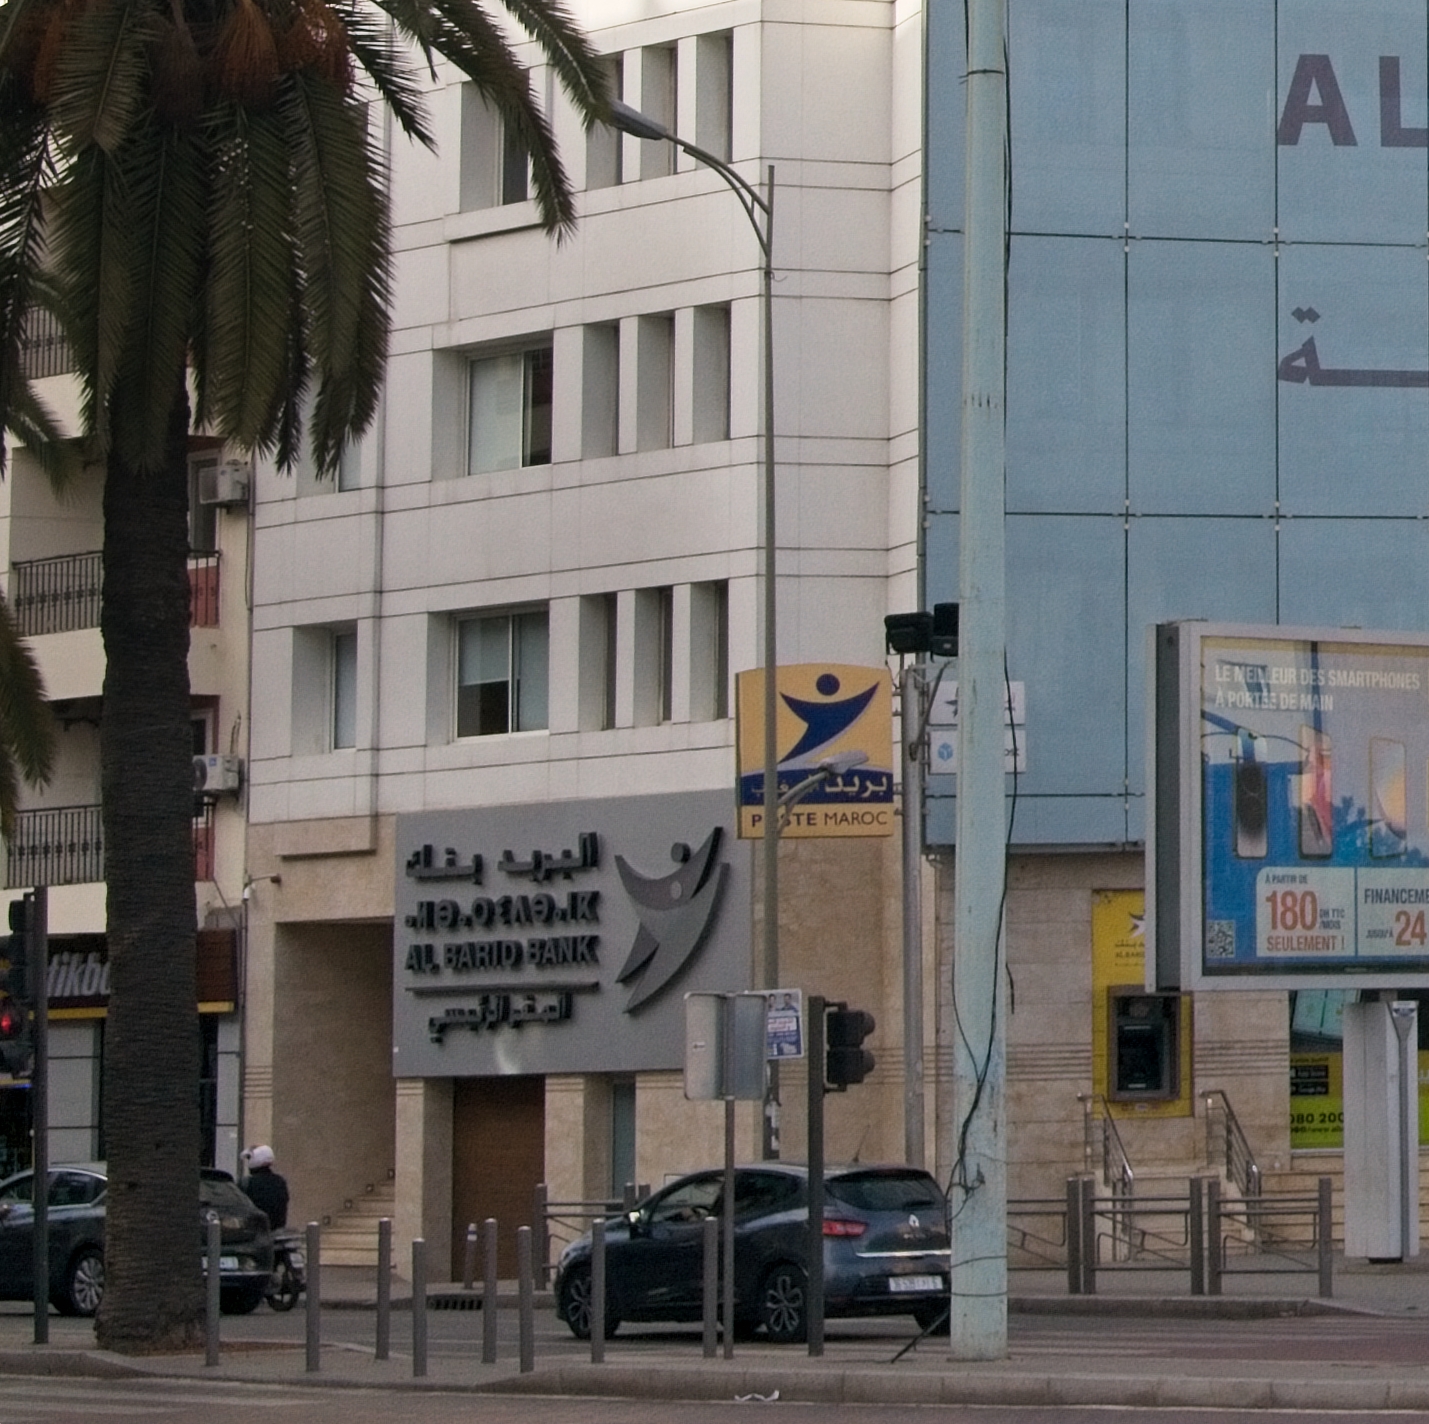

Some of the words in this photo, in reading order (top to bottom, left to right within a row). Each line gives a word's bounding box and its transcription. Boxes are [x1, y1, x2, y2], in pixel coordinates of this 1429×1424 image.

[1300, 668, 1324, 686] DES
[1327, 670, 1420, 691] SMARTPHONES
[1280, 692, 1297, 710] DE
[1300, 693, 1334, 711] MAIN
[752, 812, 817, 827] PTE
[824, 811, 888, 825] MAROC
[1265, 889, 1318, 931] 180
[1395, 909, 1427, 946] 24
[405, 943, 438, 971] AL
[444, 940, 524, 970] BARID
[528, 935, 600, 967] BANK
[1266, 935, 1337, 952] SEULEMENT
